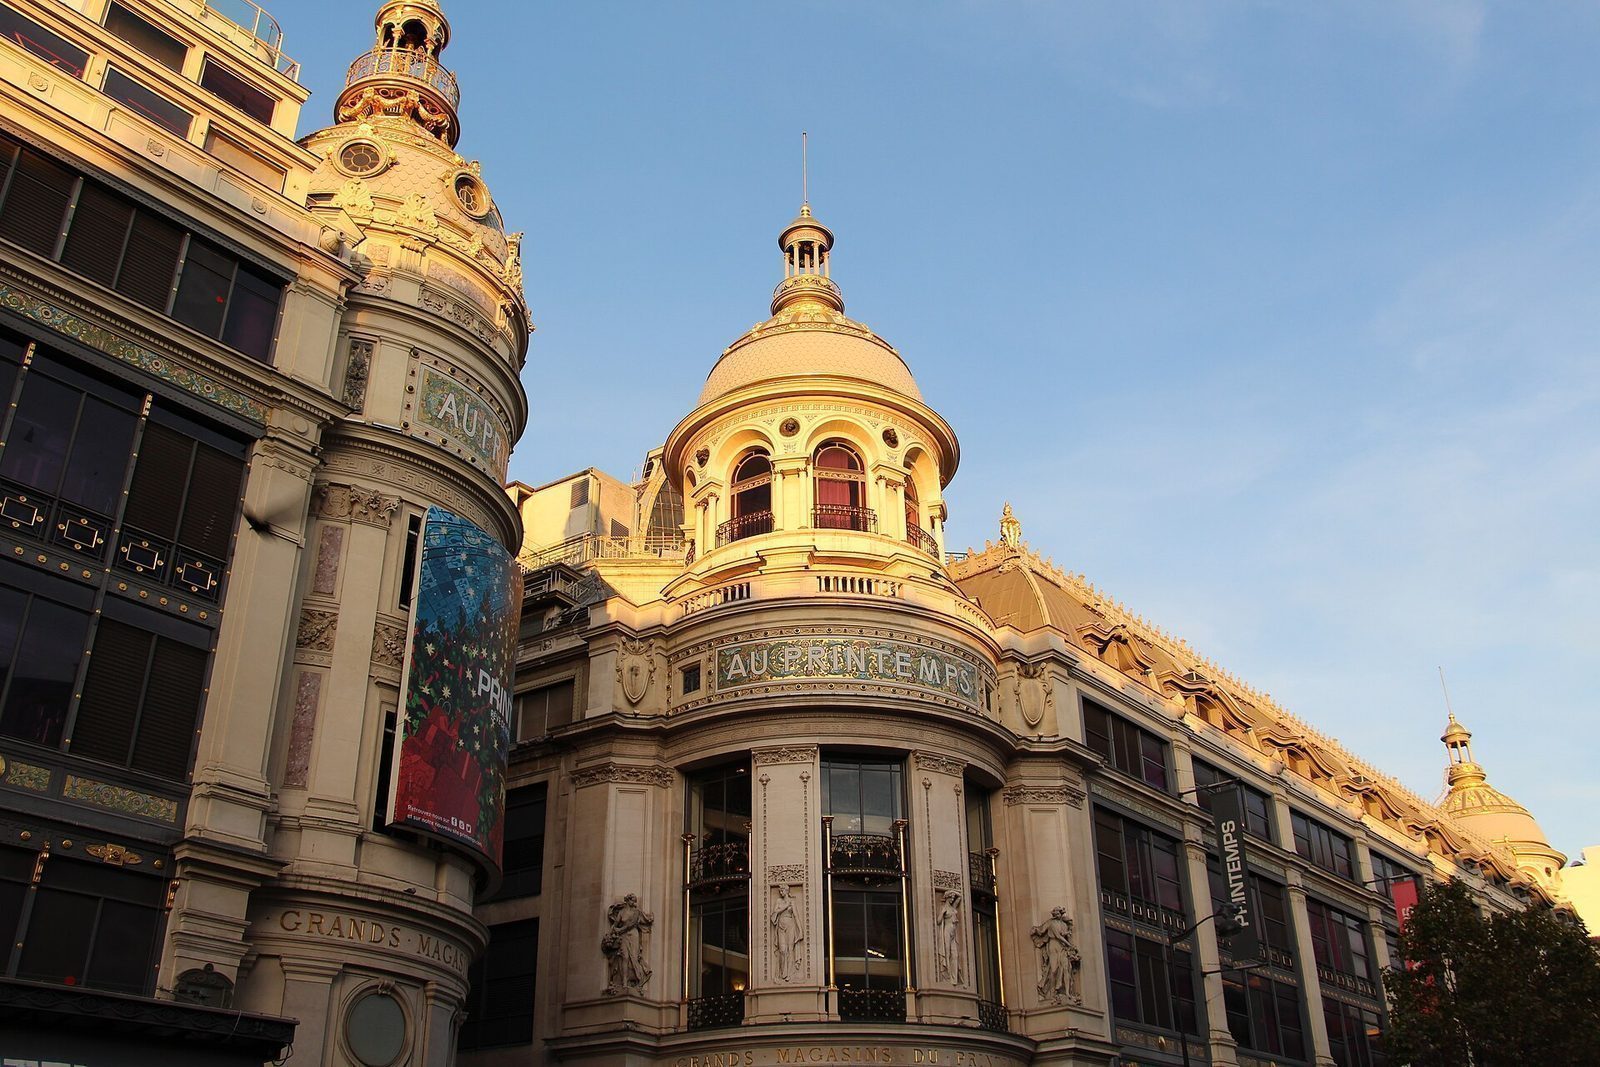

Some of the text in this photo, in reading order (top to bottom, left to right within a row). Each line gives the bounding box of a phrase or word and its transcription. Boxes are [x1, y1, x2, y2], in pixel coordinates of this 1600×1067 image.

[437, 392, 478, 438] AU
[726, 645, 973, 695] AU PRINTEMPS
[279, 909, 401, 949] GRANDS
[775, 1047, 892, 1065] MAGASINS
[912, 1048, 939, 1064] DU
